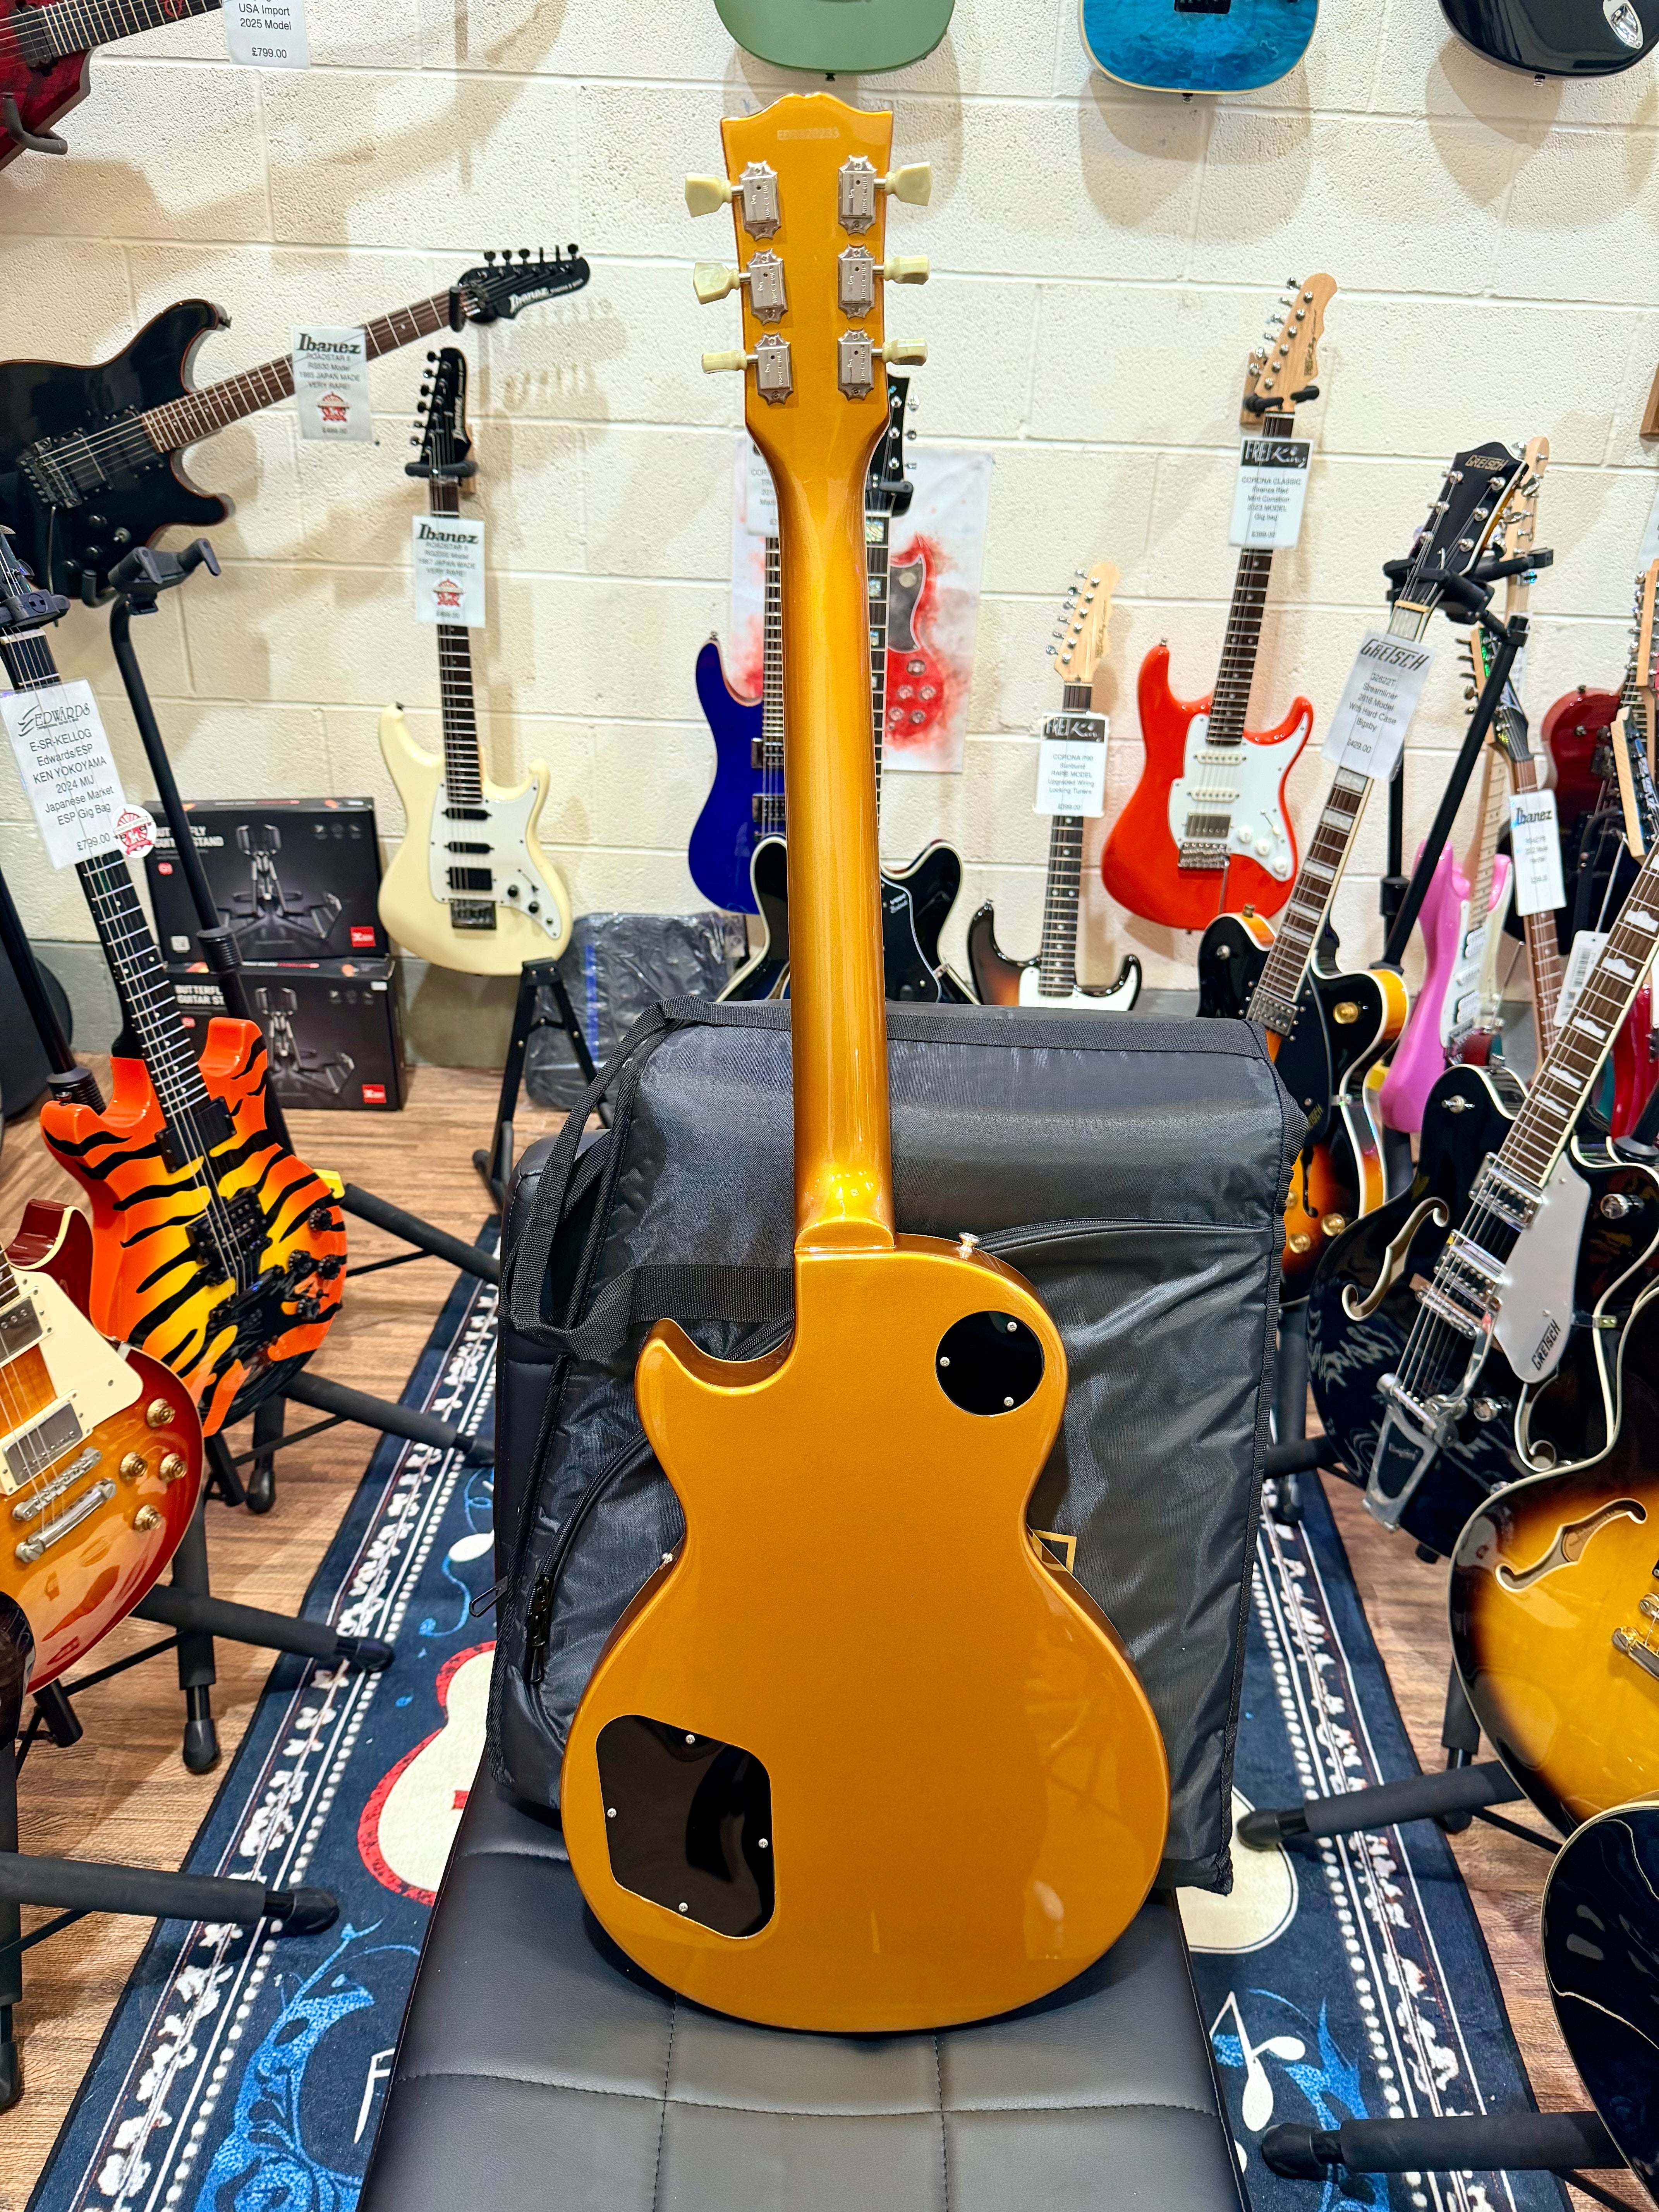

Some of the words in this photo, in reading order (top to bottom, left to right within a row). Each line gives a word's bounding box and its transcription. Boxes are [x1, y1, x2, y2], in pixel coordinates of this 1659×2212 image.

[239, 3, 259, 14] USA
[262, 5, 290, 17] Import
[240, 18, 262, 28] 2025
[265, 20, 291, 30] Model
[252, 47, 287, 58] £799.00
[297, 333, 361, 354] Ibanez
[316, 372, 339, 380] JAPAN
[1465, 455, 1509, 471] GRETSCH
[1242, 476, 1271, 484] CORONA
[1273, 477, 1302, 485] CLASSIC
[417, 523, 479, 544] Ibanez
[1360, 638, 1429, 672] GRETSCH
[1362, 682, 1398, 700] Streamliner
[1349, 701, 1361, 713] With
[1362, 707, 1377, 719] Hard
[1378, 713, 1397, 725] Case
[1373, 698, 1394, 711] Model
[35, 703, 90, 726] EDWARDS
[1356, 718, 1378, 732] Bigsby
[29, 728, 92, 752] E-SR-KELLOG
[37, 744, 93, 766] Edwards/ESP
[33, 769, 53, 784] KEN
[55, 756, 107, 778] YOKOYAMA
[56, 779, 78, 794] 2024
[80, 775, 94, 789] MIJ
[45, 794, 86, 813] Japanese
[87, 785, 113, 801] Market
[57, 811, 76, 826] ESP
[78, 809, 94, 821] Gig
[96, 803, 111, 816] Bag
[1516, 807, 1553, 826] Ibanez
[77, 832, 110, 851] £799.00
[175, 984, 223, 996] BUTTERFL
[177, 994, 211, 1005] GUITAR
[1532, 1318, 1561, 1370] GRETSCH
